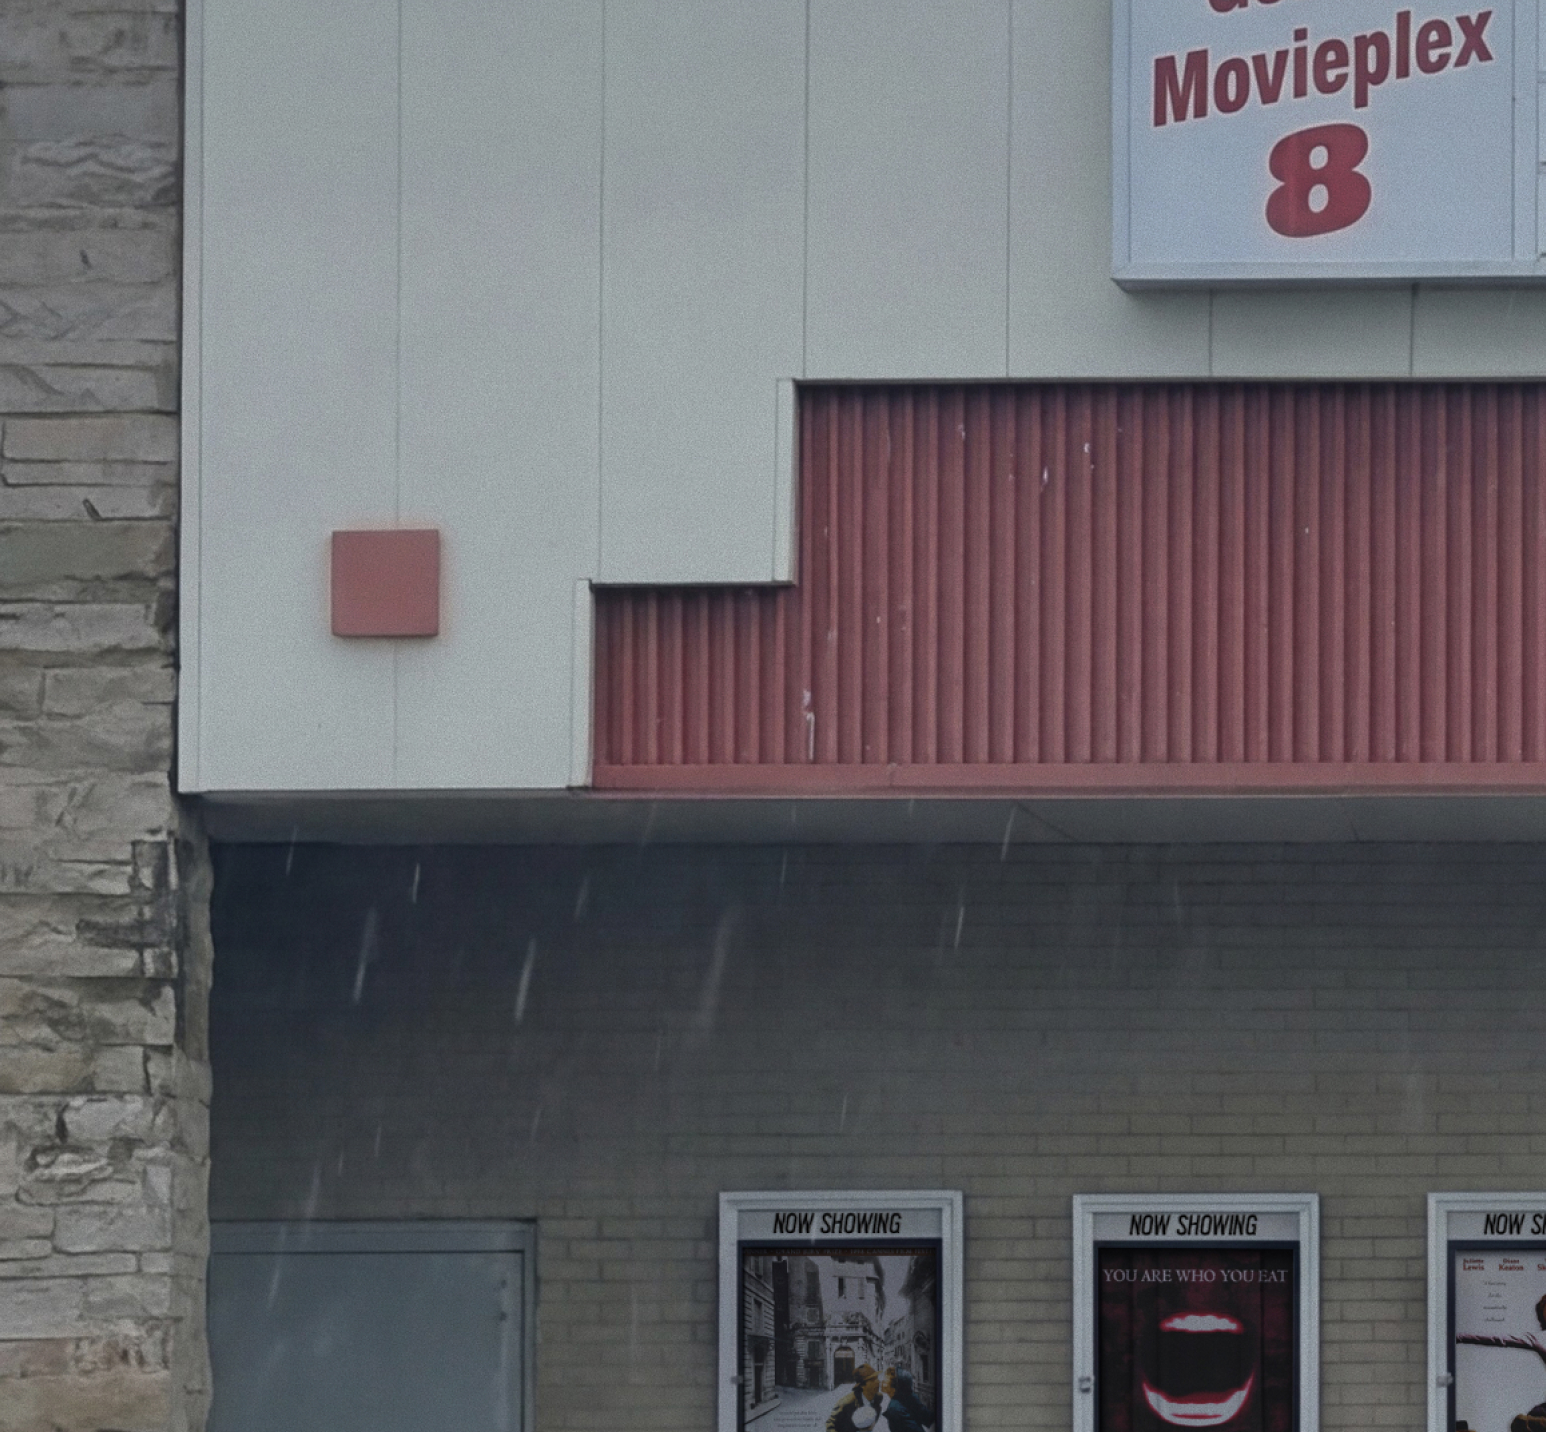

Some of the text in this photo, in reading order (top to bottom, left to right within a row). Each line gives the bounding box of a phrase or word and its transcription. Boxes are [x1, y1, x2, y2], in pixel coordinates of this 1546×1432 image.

[1153, 10, 1494, 127] Movieplex
[1265, 123, 1372, 238] 8
[773, 1212, 901, 1234] NOW SHOWING
[1129, 1214, 1257, 1236] NOW SHOWING
[1483, 1213, 1525, 1235] NOW
[1102, 1269, 1289, 1283] YOU ARE WHO YOU EAT
